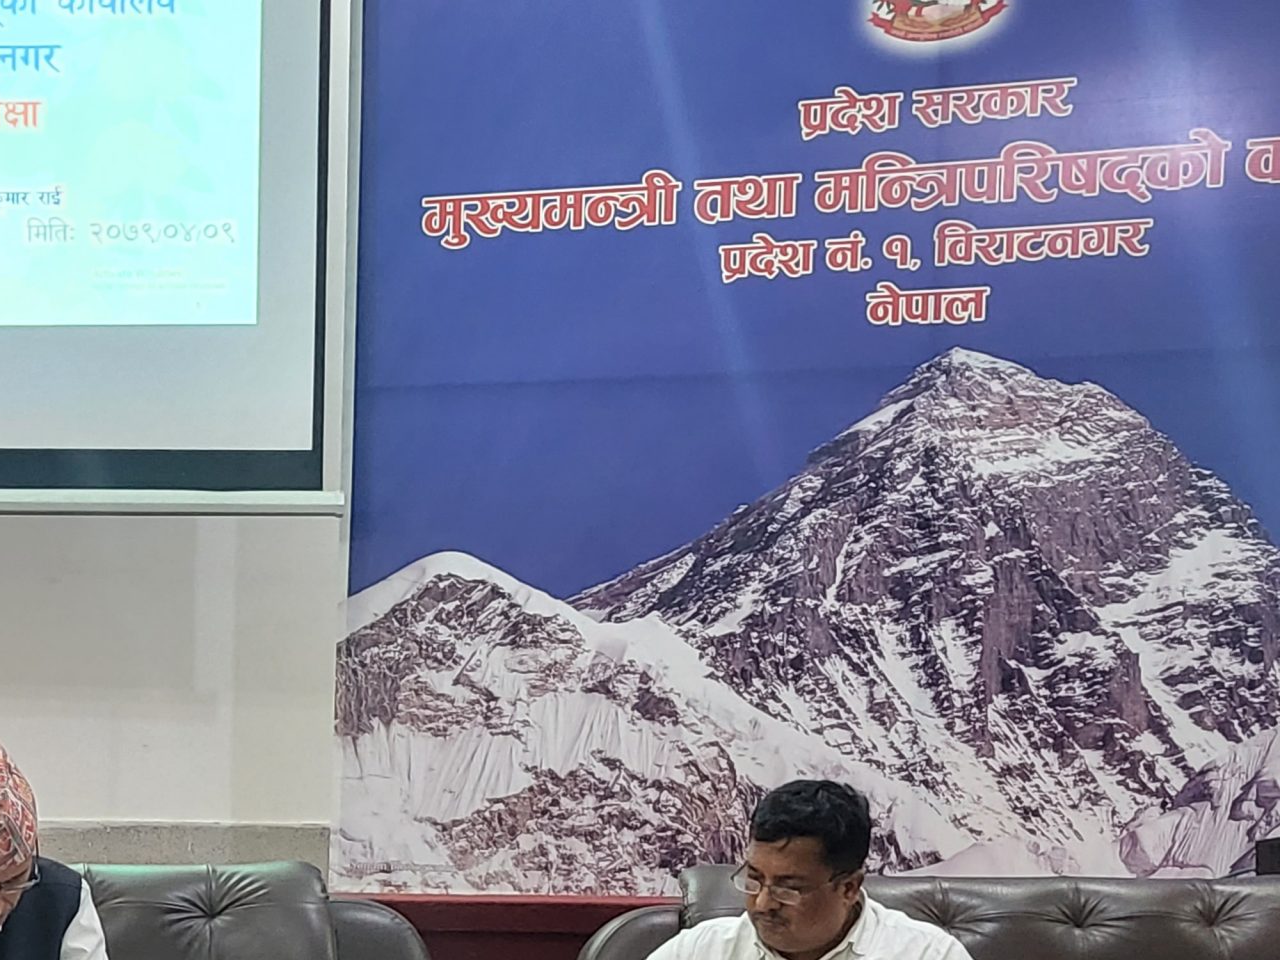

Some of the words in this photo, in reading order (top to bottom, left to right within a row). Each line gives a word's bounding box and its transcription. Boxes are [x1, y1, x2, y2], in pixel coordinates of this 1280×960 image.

[799, 86, 904, 141] प्रदेश
[912, 76, 1078, 128] सरकार
[37, 185, 64, 206] राई
[421, 169, 683, 250] मुख्यमन्त्री
[693, 172, 803, 225] तथा
[814, 128, 1232, 213] मन्त्रिपरिषद्को
[718, 232, 818, 284] प्रदेश
[825, 230, 872, 273] नं.
[882, 233, 922, 273] १,
[933, 218, 1154, 268] विराटनगर
[865, 280, 991, 326] नेपाल
